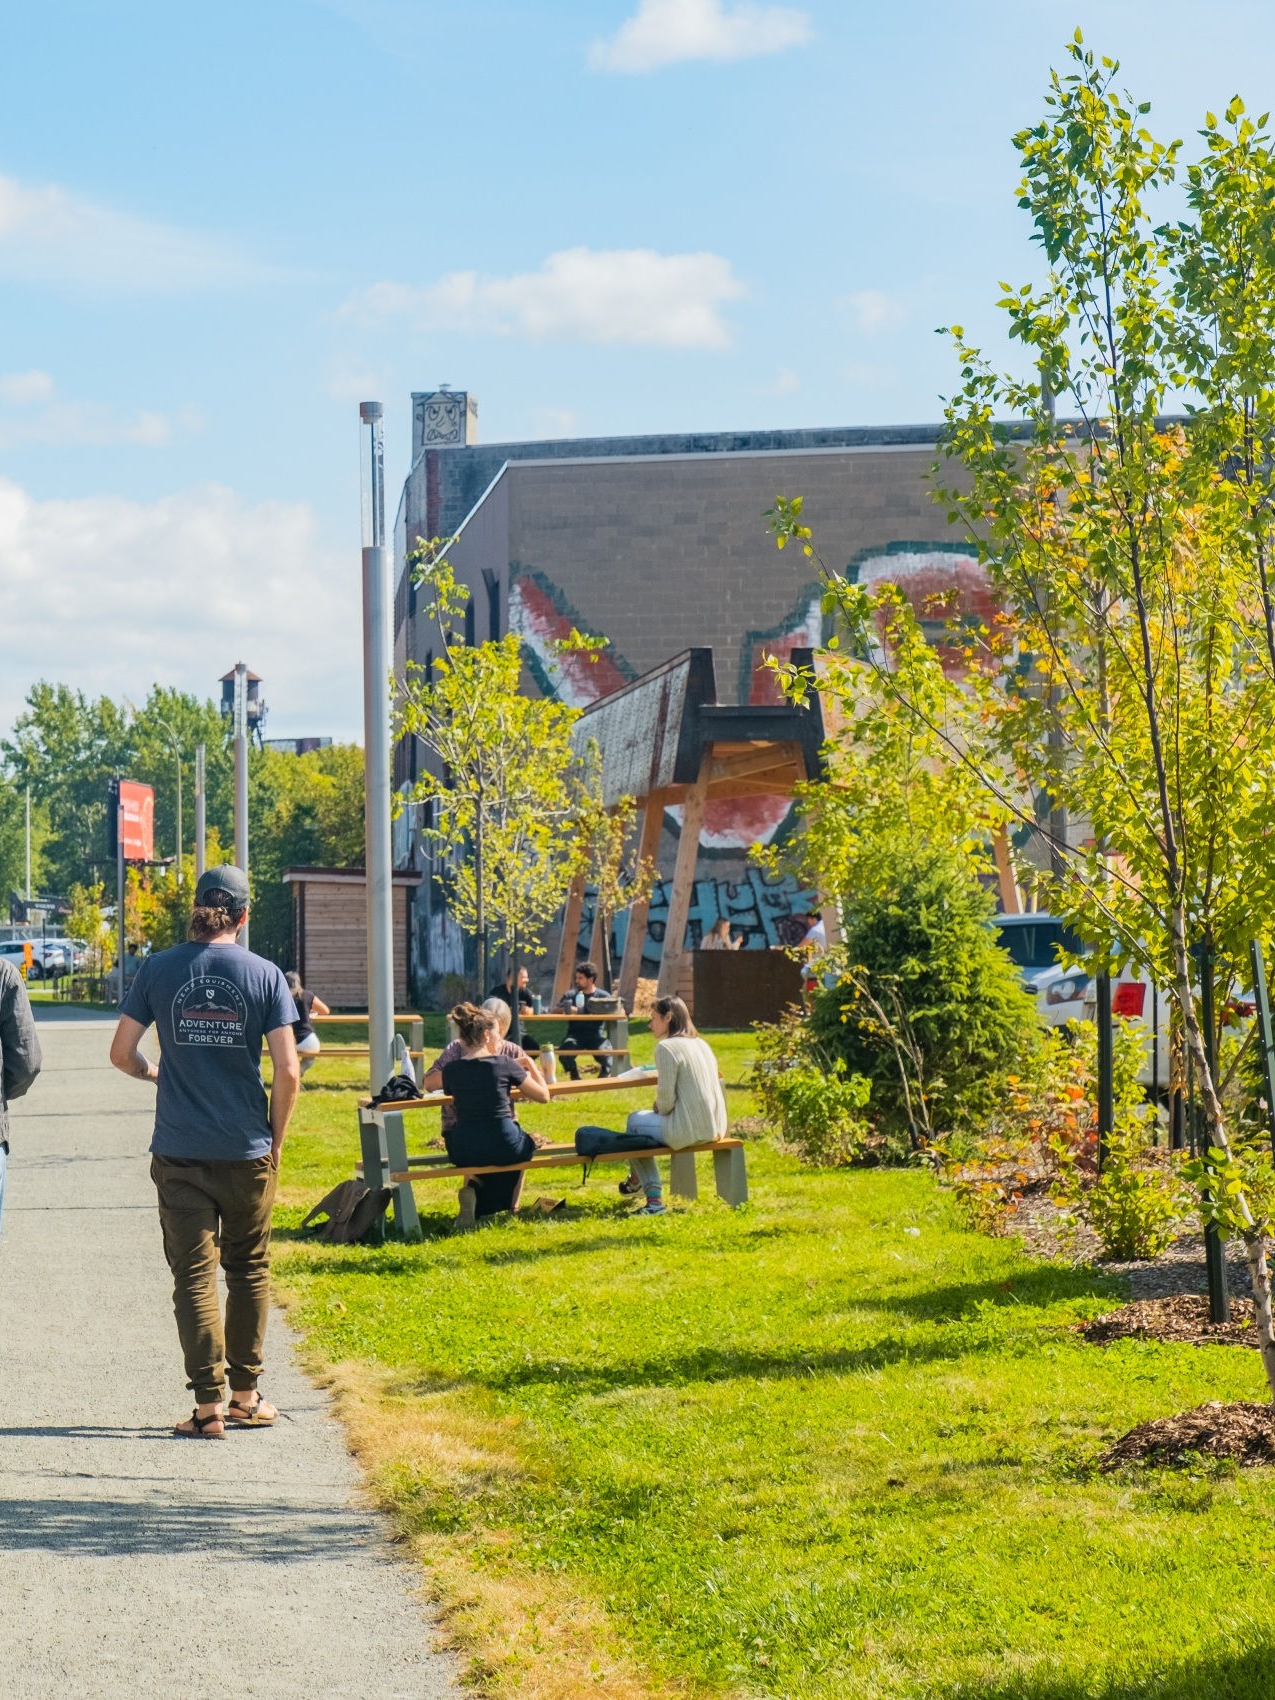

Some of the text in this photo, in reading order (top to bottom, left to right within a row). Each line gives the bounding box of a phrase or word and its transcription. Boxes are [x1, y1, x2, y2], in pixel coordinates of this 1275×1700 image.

[177, 979, 243, 1007] NEMO EQUIPMENT
[179, 1020, 242, 1030] ADVENTURE
[188, 1034, 234, 1045] FOREVER
